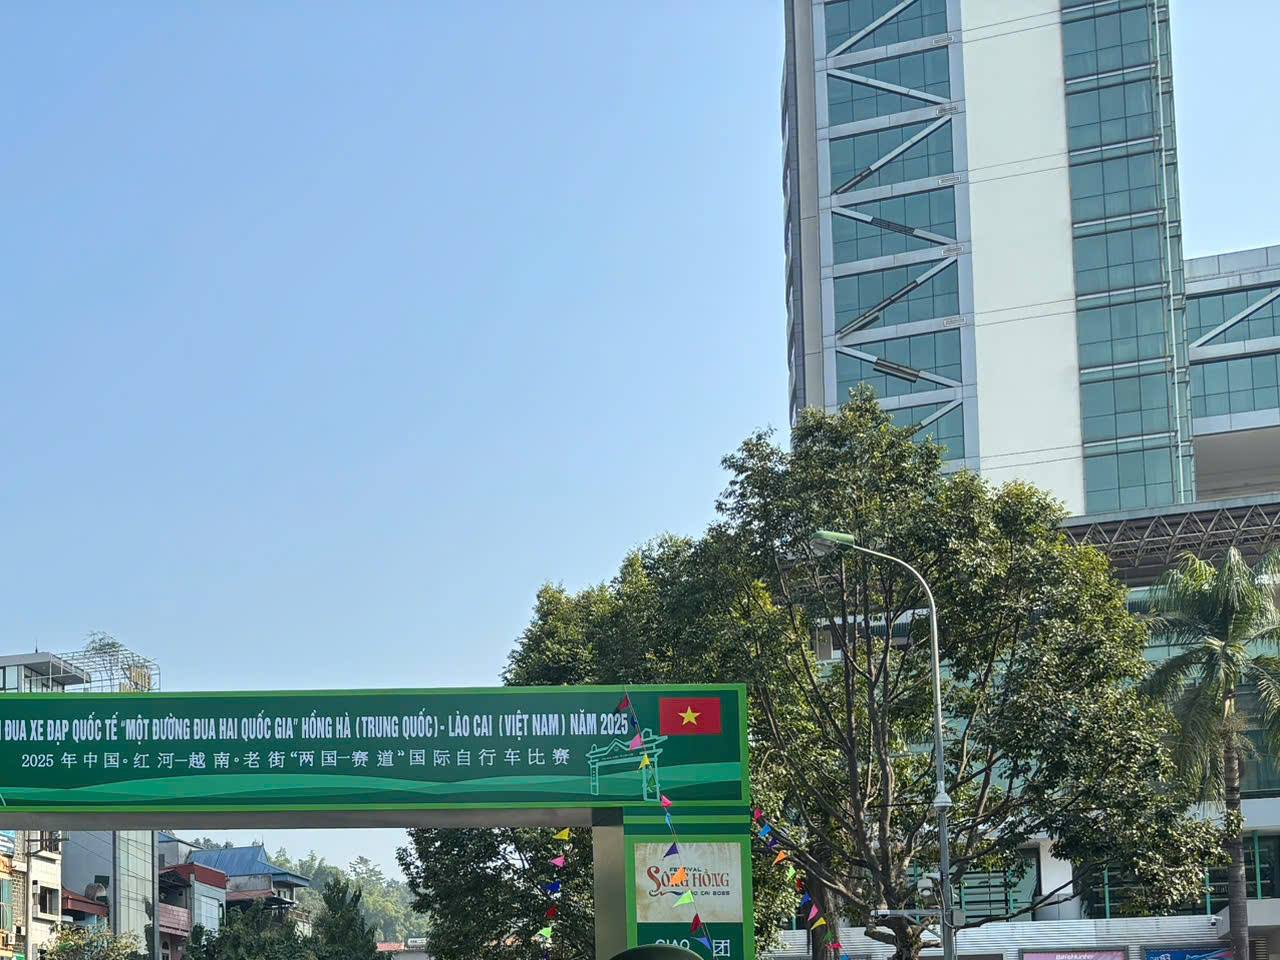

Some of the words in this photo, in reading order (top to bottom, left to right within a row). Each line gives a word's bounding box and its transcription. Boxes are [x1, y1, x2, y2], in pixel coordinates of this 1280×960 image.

[4, 719, 27, 741] ĐUA
[29, 719, 44, 741] XE
[46, 719, 69, 746] ĐẠP
[72, 711, 102, 743] QUỐC
[105, 711, 119, 741] TẾ
[152, 712, 191, 741] ĐƯỜNG
[193, 718, 216, 740] ĐUA
[219, 717, 238, 740] HAI
[241, 709, 271, 742] QUỐC
[301, 709, 332, 739] HỒNG
[335, 712, 351, 739] HÀ
[448, 710, 470, 737] LÀO
[473, 714, 493, 737] CAI
[569, 709, 597, 735] NĂM
[600, 713, 629, 735] 2025
